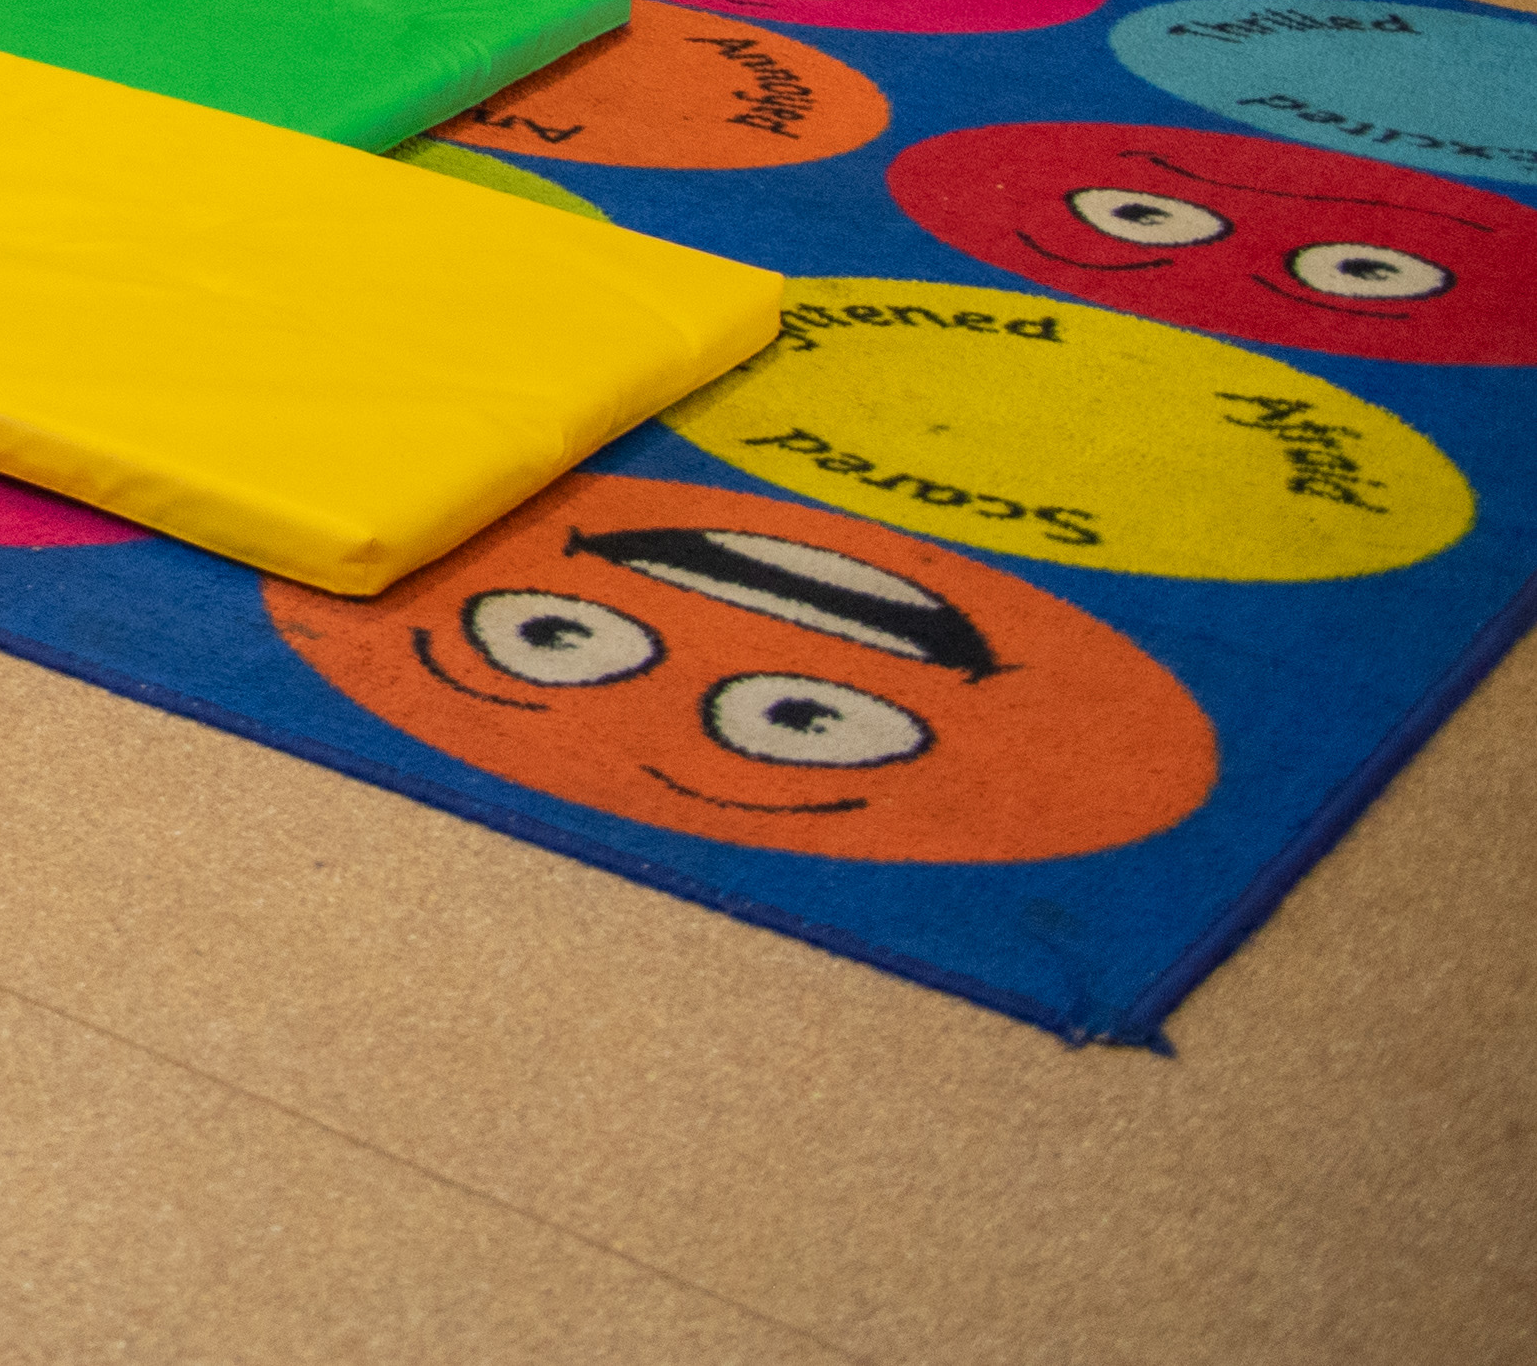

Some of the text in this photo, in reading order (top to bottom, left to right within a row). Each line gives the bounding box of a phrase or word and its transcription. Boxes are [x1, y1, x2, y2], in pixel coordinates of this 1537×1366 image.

[1166, 8, 1422, 44] Thrilled
[684, 37, 816, 140] Annoyed
[742, 427, 1104, 546] Scared
[1214, 391, 1388, 516] Afraid
